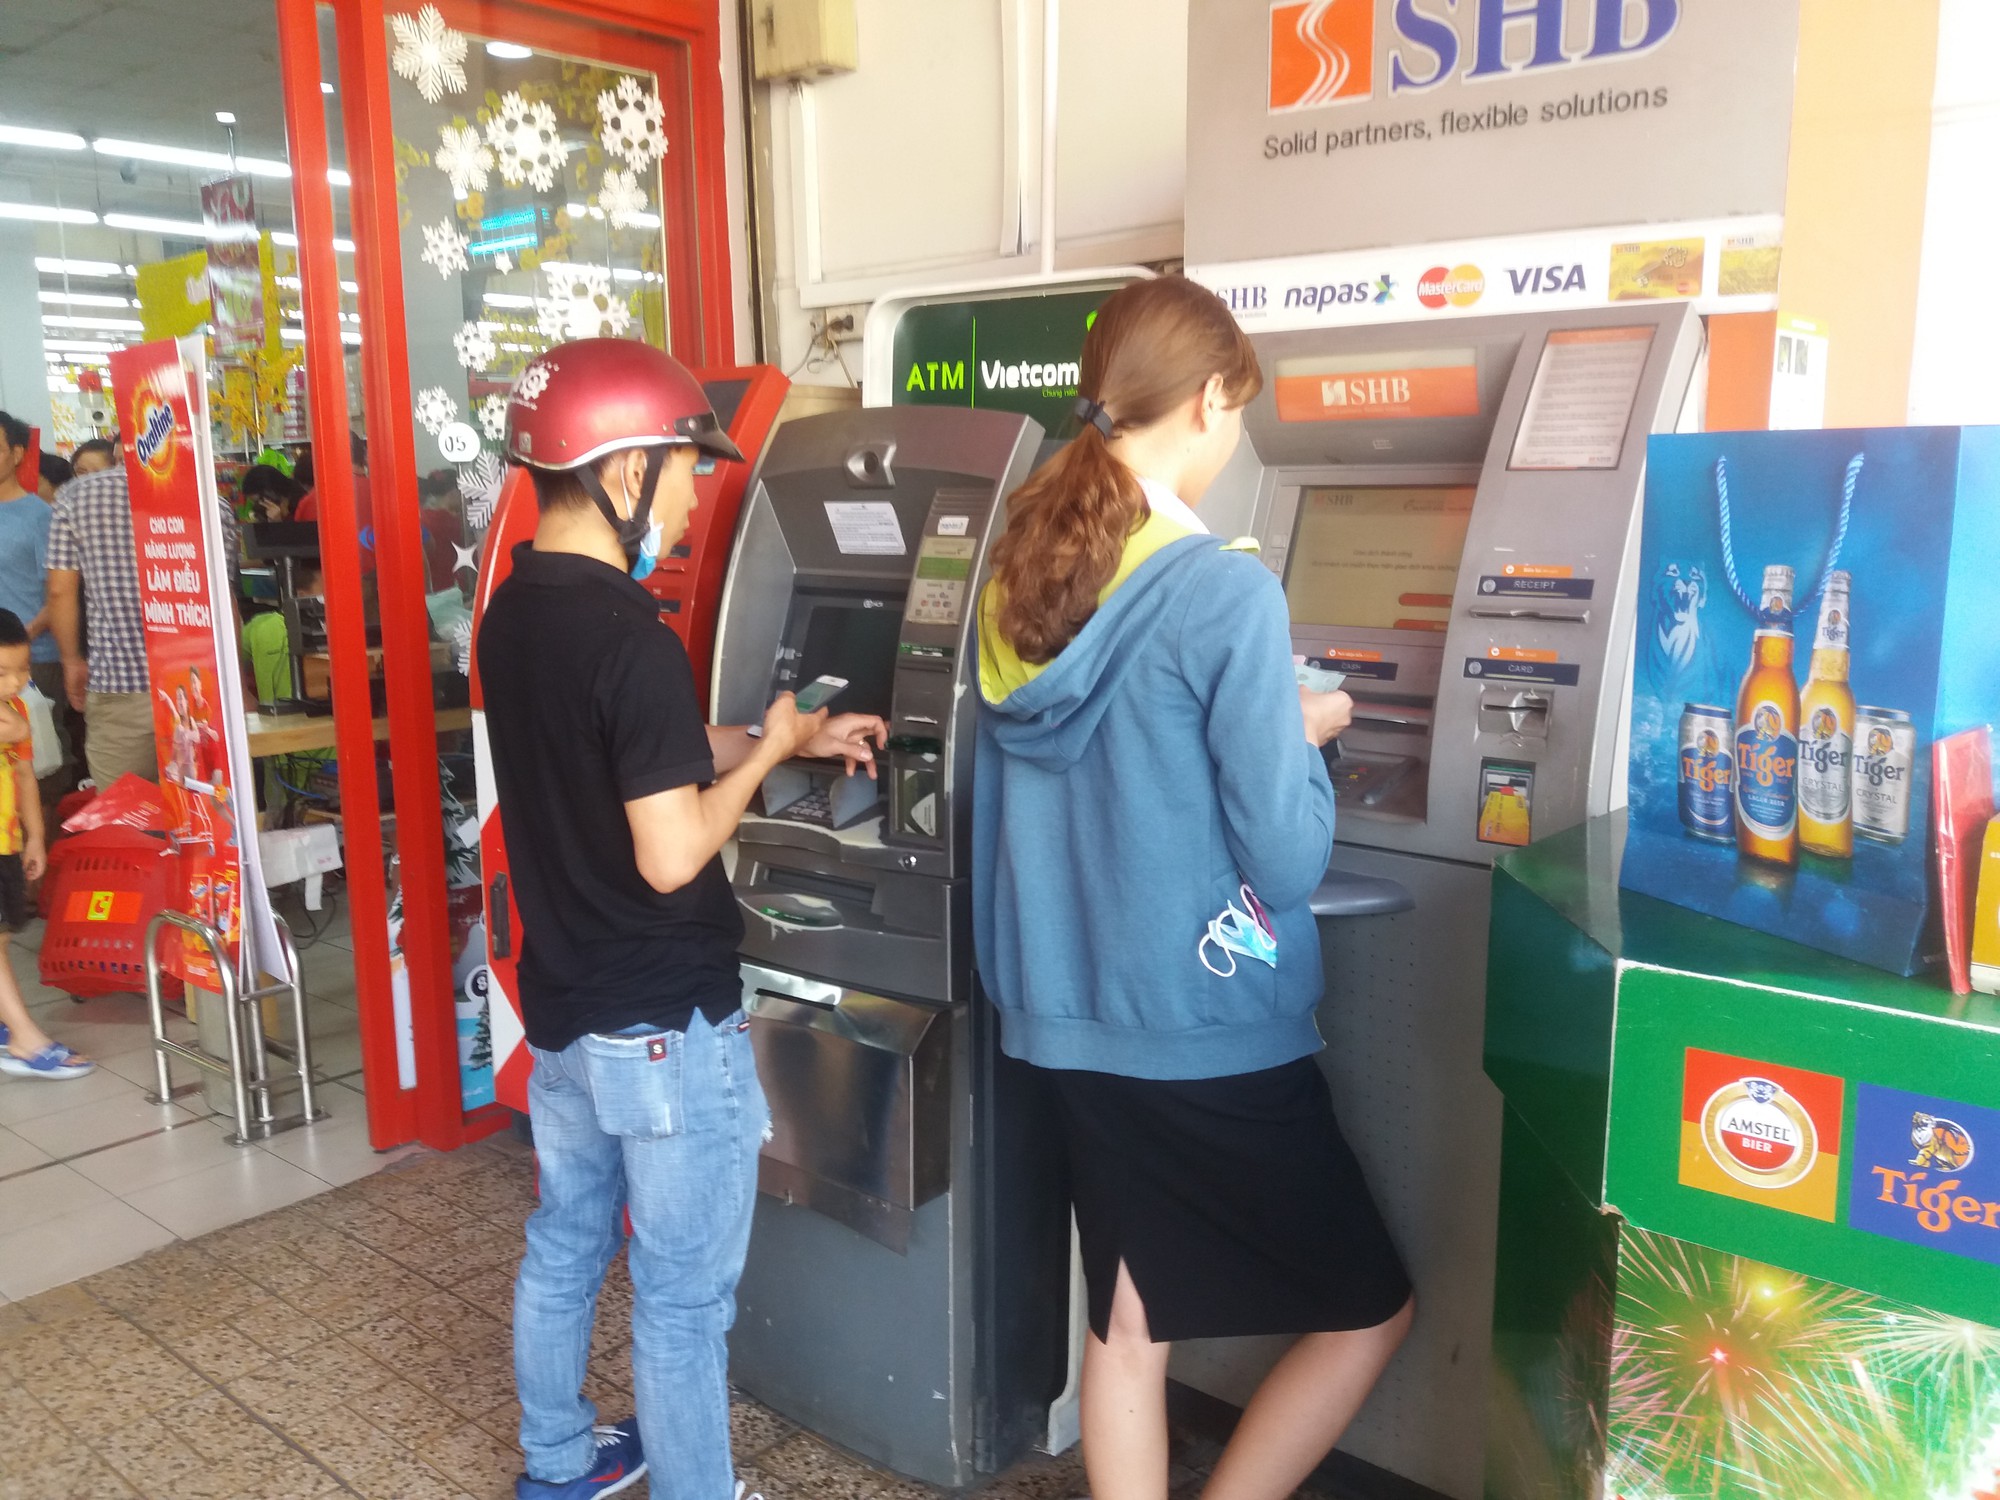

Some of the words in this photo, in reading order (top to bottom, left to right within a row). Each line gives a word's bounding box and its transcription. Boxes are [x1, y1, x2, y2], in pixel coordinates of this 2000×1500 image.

[1391, 0, 1680, 94] SHB
[1263, 127, 1317, 160] Solid
[1325, 119, 1432, 156] partners,
[1441, 102, 1529, 136] flexible
[1541, 86, 1668, 123] solutions
[1418, 278, 1484, 297] MasterCard
[1503, 264, 1587, 295] VISA
[1284, 280, 1369, 314] napas
[906, 360, 964, 392] ATM
[1350, 377, 1411, 405] SHB
[136, 402, 174, 464] Ovaltine
[444, 435, 466, 452] 05
[149, 516, 167, 534] CHO
[168, 516, 185, 534] CON
[146, 563, 172, 592] LÀM
[1514, 580, 1556, 589] RECEIPT
[144, 596, 175, 624] MÌNH
[175, 598, 211, 628] THÍCH
[1508, 664, 1534, 673] CARD
[1738, 743, 1795, 786] Tiger
[1799, 740, 1848, 773] Tiger
[1854, 754, 1905, 786] Tiger
[1683, 757, 1731, 792] Tiger
[1802, 777, 1844, 793] CRYSTAL
[1856, 788, 1897, 804] CRYSTAL
[1728, 1117, 1791, 1143] AMSTEL
[1741, 1137, 1773, 1153] BIER
[1871, 1165, 2000, 1233] Tiger
